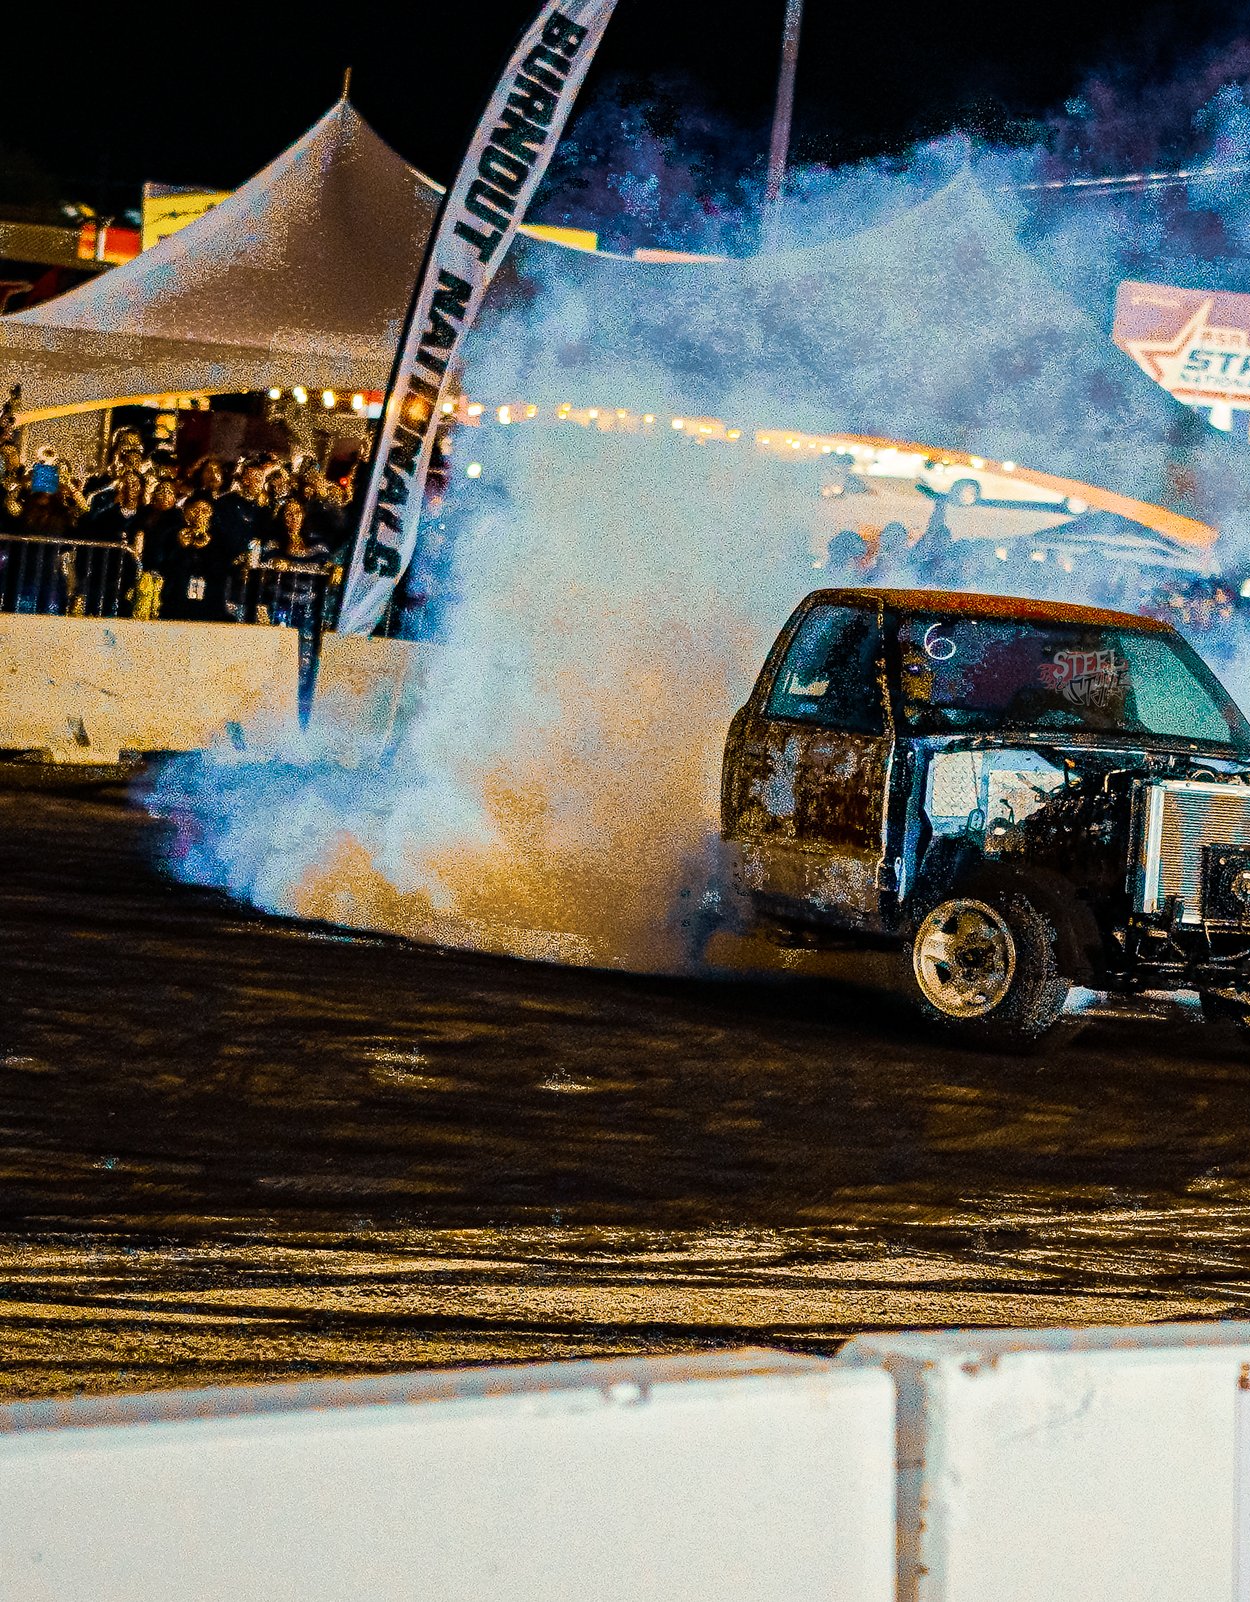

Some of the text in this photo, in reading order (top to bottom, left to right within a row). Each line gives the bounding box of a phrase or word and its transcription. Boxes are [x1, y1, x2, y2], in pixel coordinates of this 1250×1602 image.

[453, 10, 588, 263] BURNOUT
[924, 622, 957, 660] 6
[1053, 649, 1126, 681] STEEL
